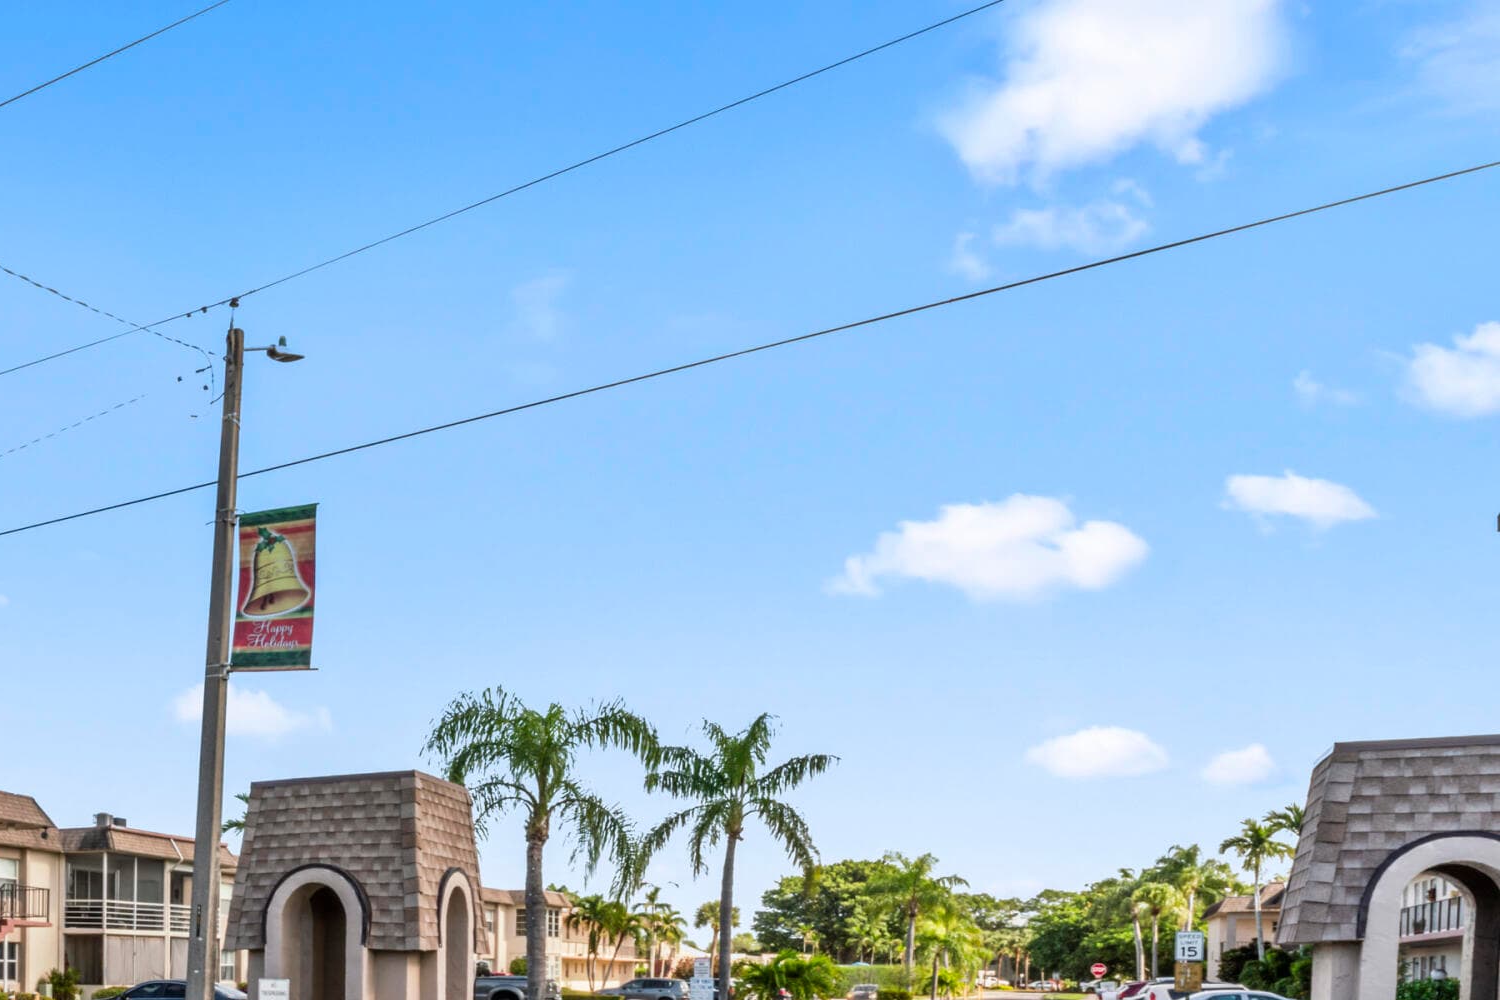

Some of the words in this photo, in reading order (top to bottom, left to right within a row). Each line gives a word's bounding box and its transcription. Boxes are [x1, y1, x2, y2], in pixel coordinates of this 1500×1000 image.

[253, 620, 294, 636] Happy
[247, 634, 299, 649] Holidays
[1180, 946, 1198, 957] 15
